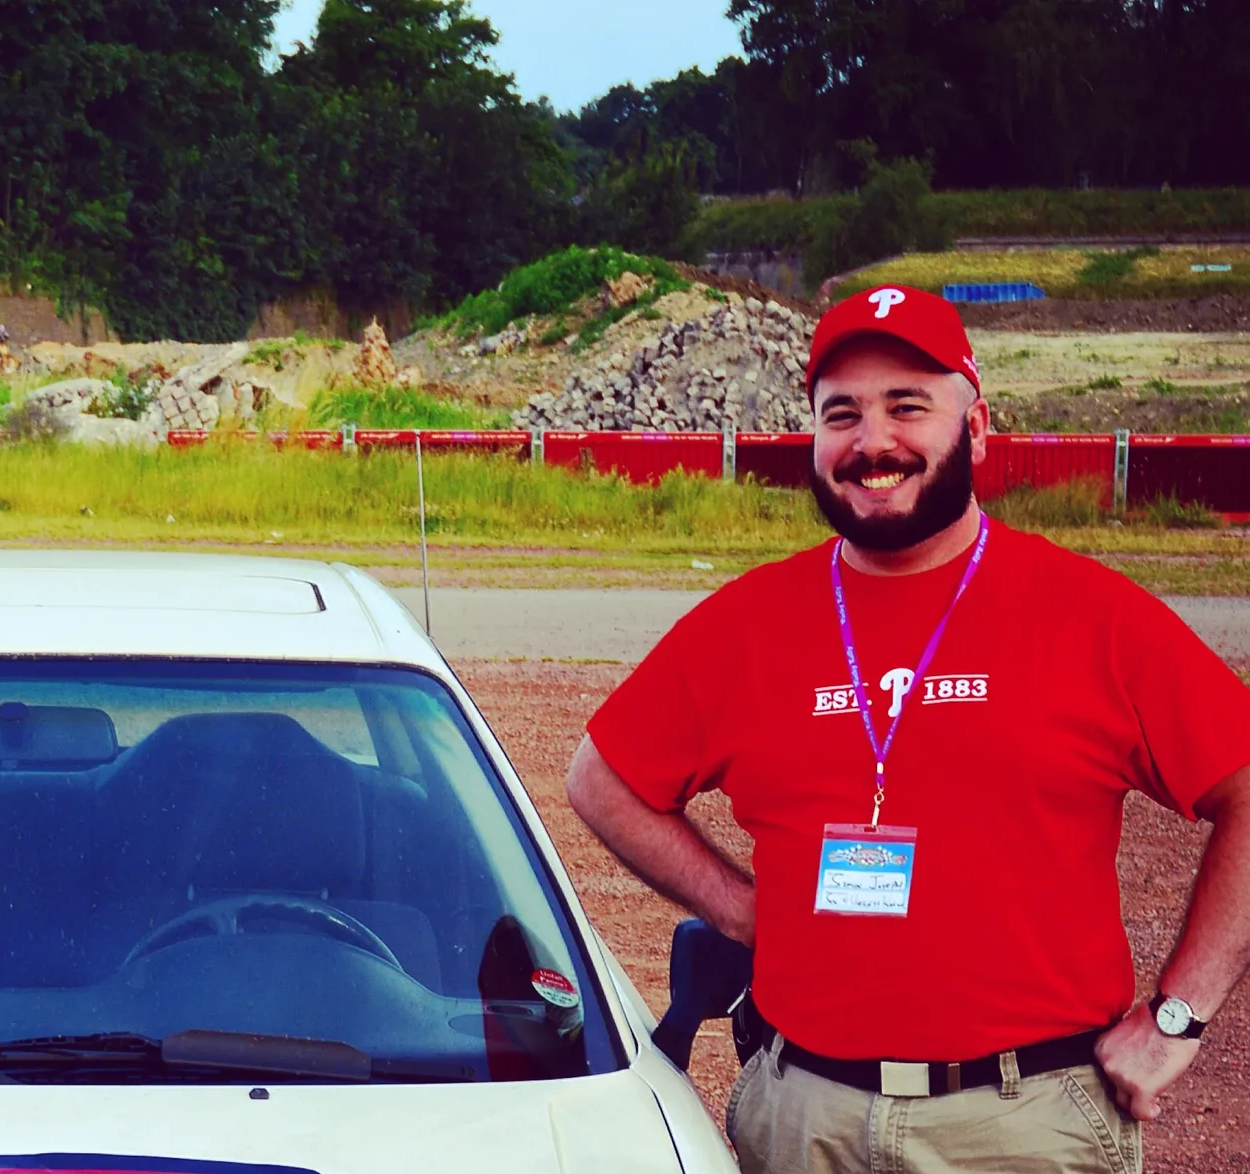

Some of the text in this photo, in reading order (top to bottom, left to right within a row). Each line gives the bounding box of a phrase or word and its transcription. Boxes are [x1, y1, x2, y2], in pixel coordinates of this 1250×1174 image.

[868, 288, 906, 318] P
[879, 667, 915, 718] P
[923, 679, 988, 699] 1883
